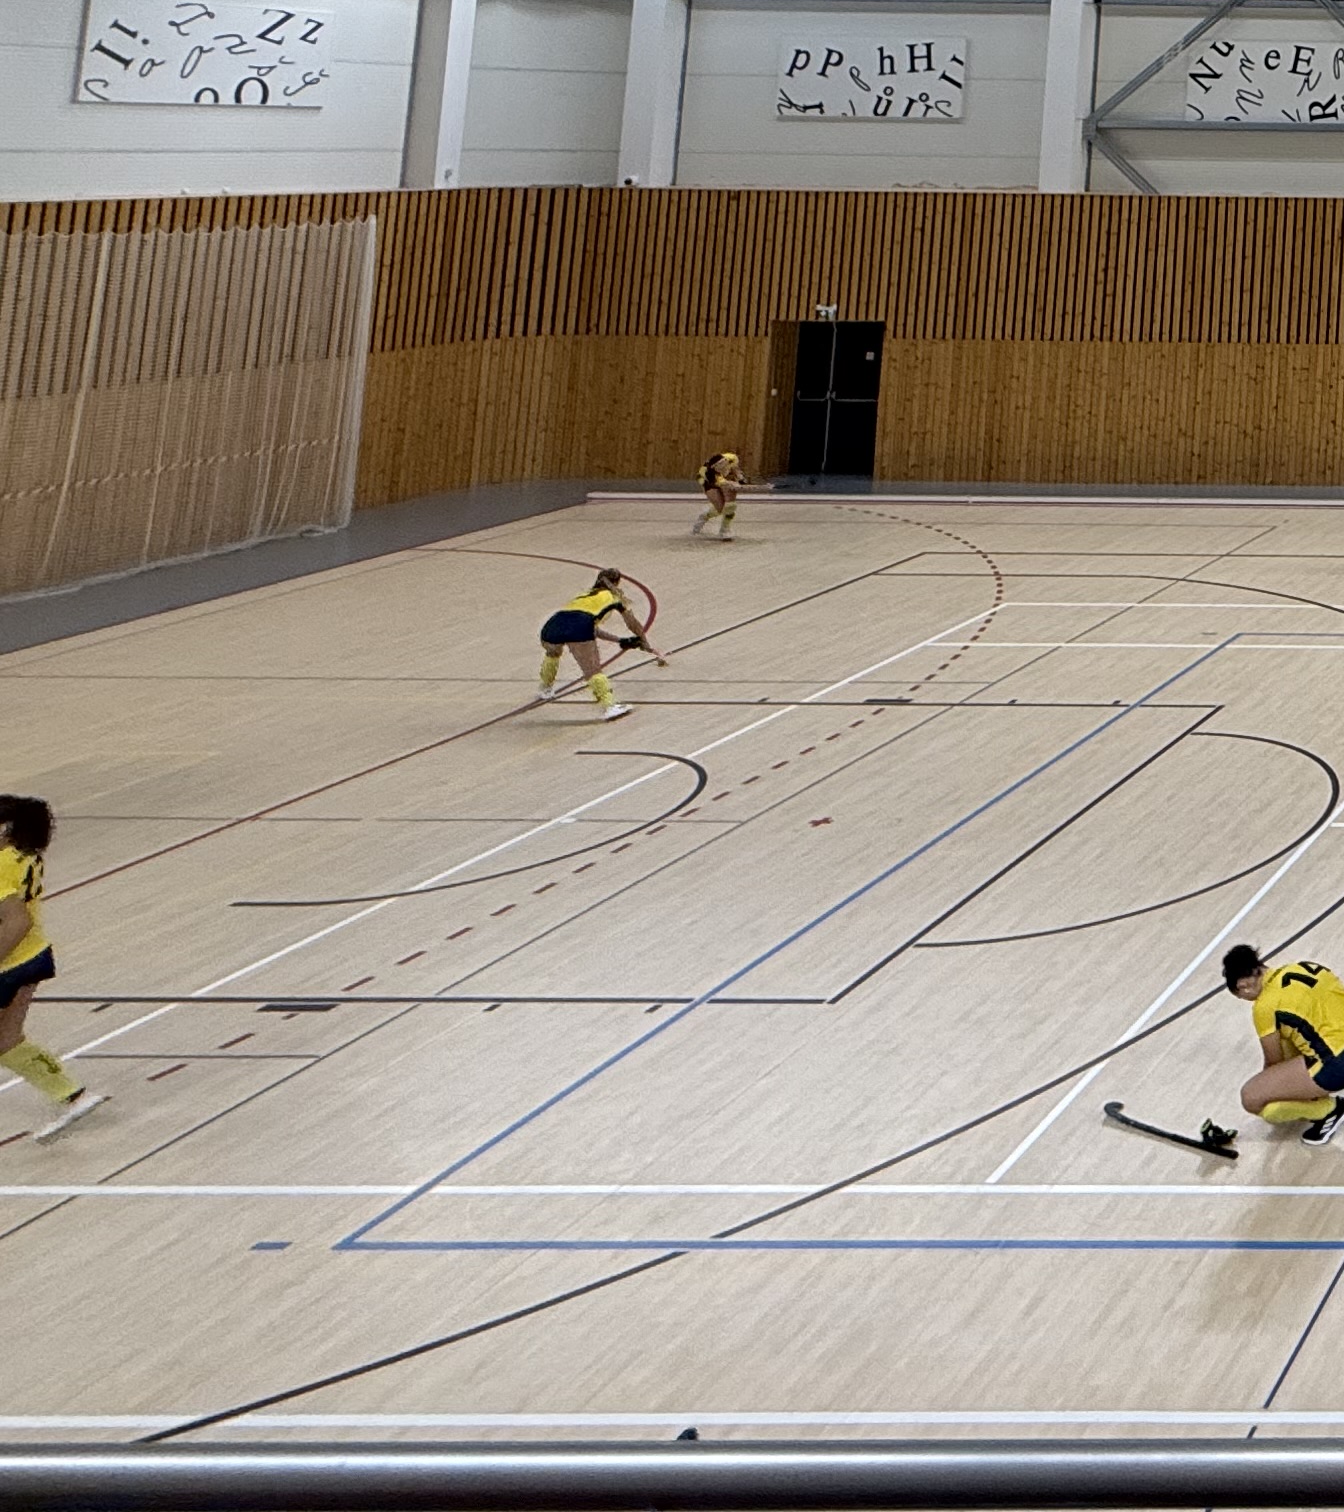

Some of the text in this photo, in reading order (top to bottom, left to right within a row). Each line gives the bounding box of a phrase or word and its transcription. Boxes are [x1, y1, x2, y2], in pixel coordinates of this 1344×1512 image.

[877, 46, 897, 76] h
[905, 42, 936, 73] H
[1264, 49, 1281, 70] e
[1288, 45, 1316, 76] E
